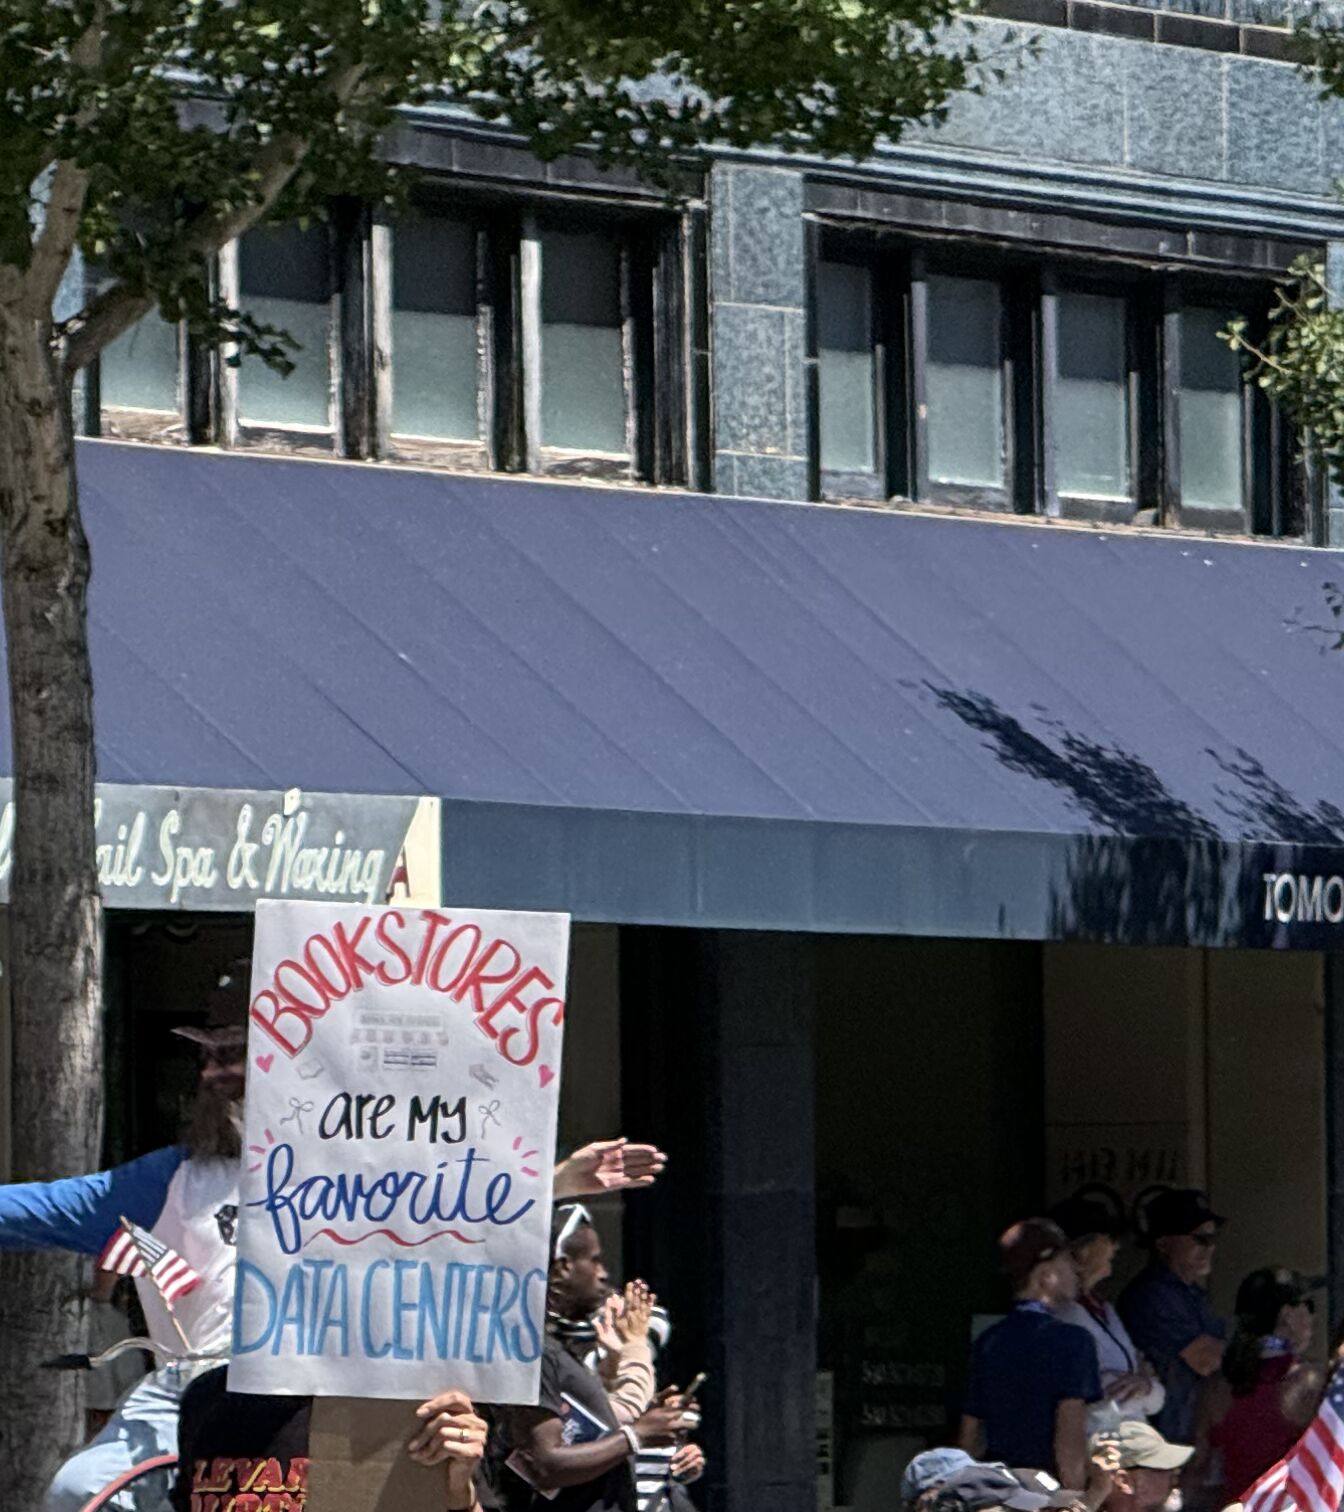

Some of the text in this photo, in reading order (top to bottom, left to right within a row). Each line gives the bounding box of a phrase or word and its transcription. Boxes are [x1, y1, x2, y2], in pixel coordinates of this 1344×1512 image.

[94, 798, 146, 888] ail
[152, 808, 218, 903] Spa
[227, 804, 259, 890] &
[262, 812, 385, 904] Waxing
[251, 911, 564, 1066] BOOKSTORES
[318, 1091, 396, 1140] are
[246, 1143, 536, 1255] favorite
[232, 1258, 547, 1364] DATA CENTERS
